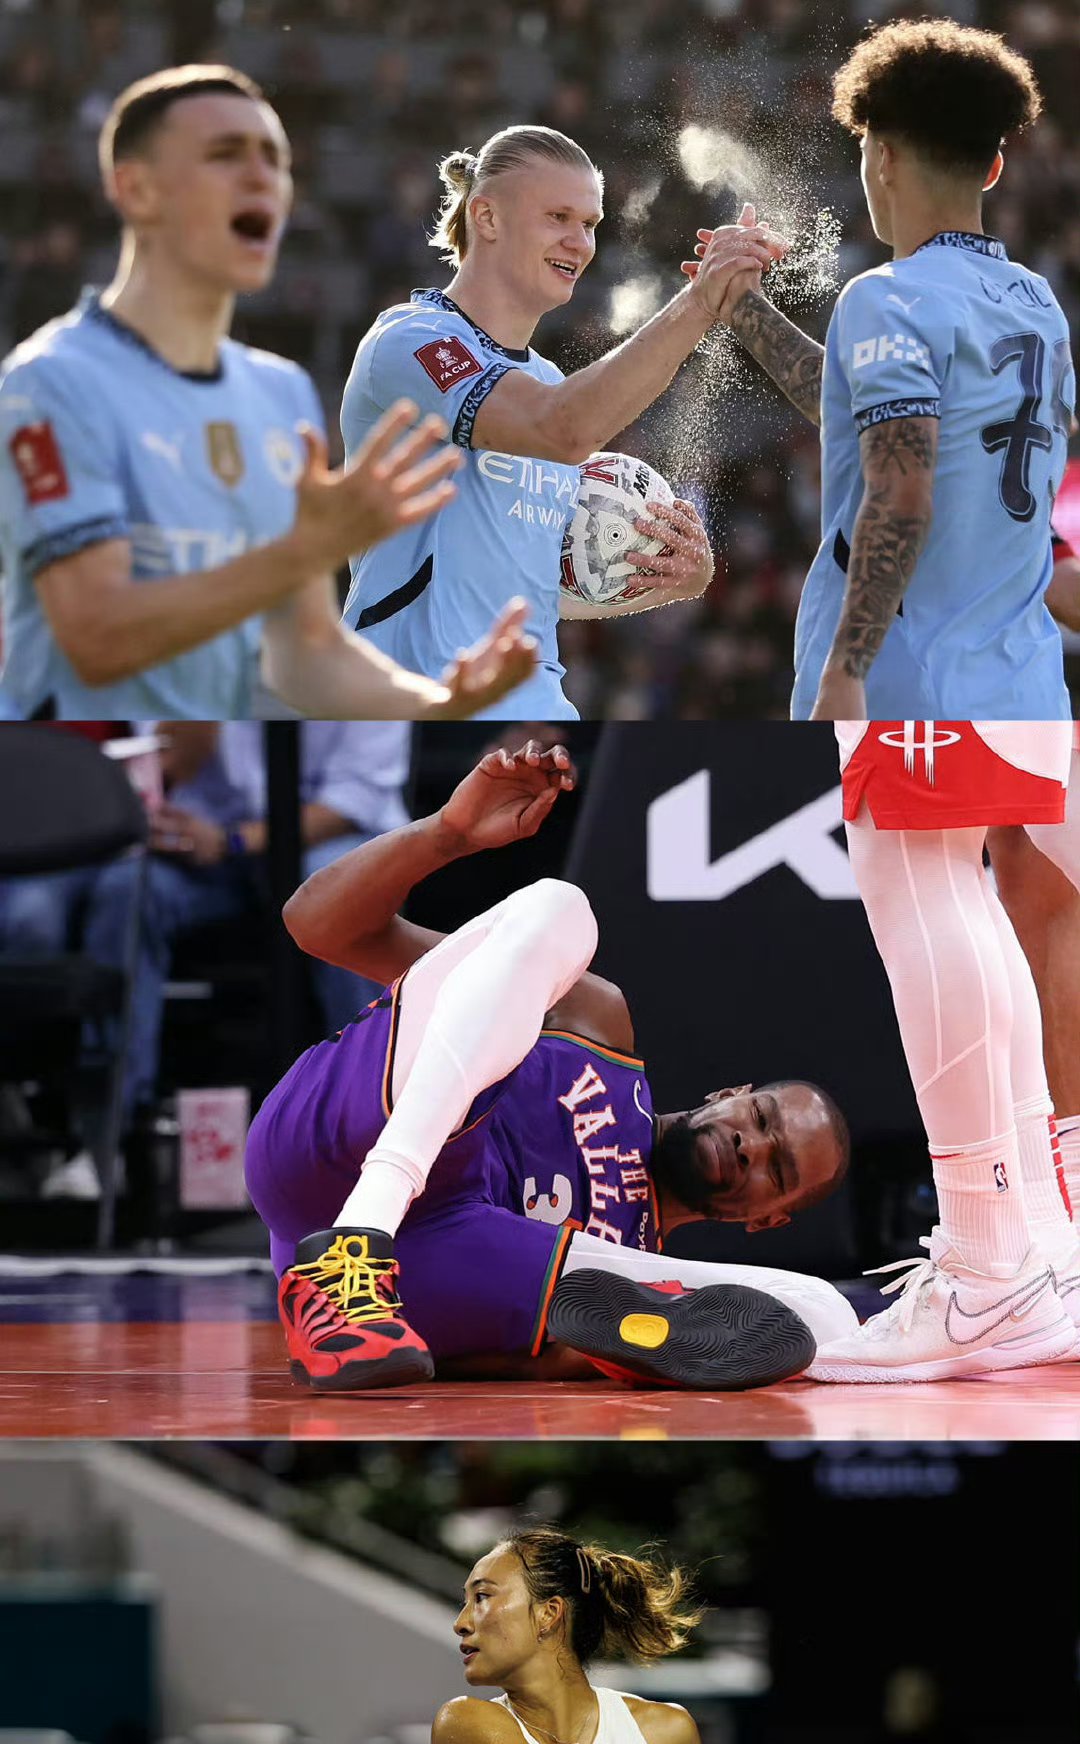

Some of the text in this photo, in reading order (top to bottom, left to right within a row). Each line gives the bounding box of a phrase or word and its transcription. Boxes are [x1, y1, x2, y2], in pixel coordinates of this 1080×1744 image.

[440, 360, 471, 381] FA CUP
[619, 1147, 650, 1203] THE
